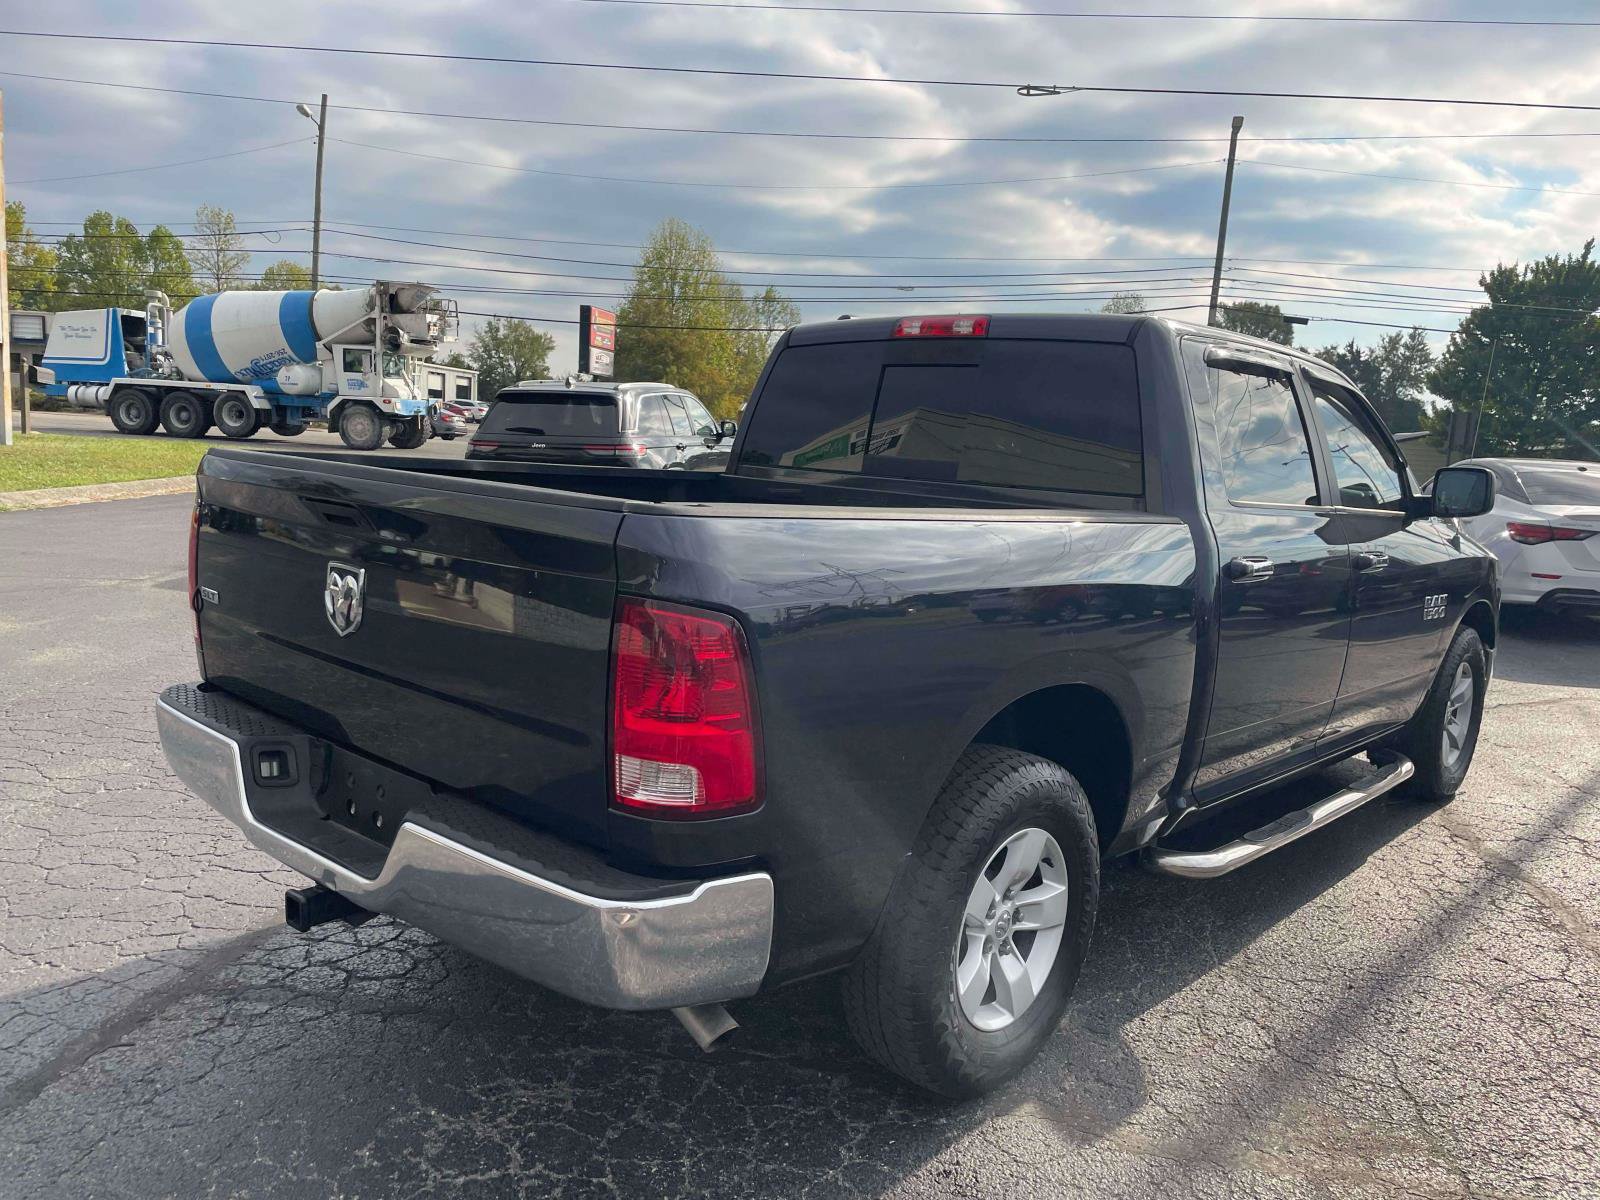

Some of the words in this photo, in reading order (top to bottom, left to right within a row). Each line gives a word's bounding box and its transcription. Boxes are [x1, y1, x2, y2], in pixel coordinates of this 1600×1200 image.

[201, 589, 217, 602] SLT
[1425, 594, 1448, 607] RAM
[1424, 606, 1446, 620] 1500
